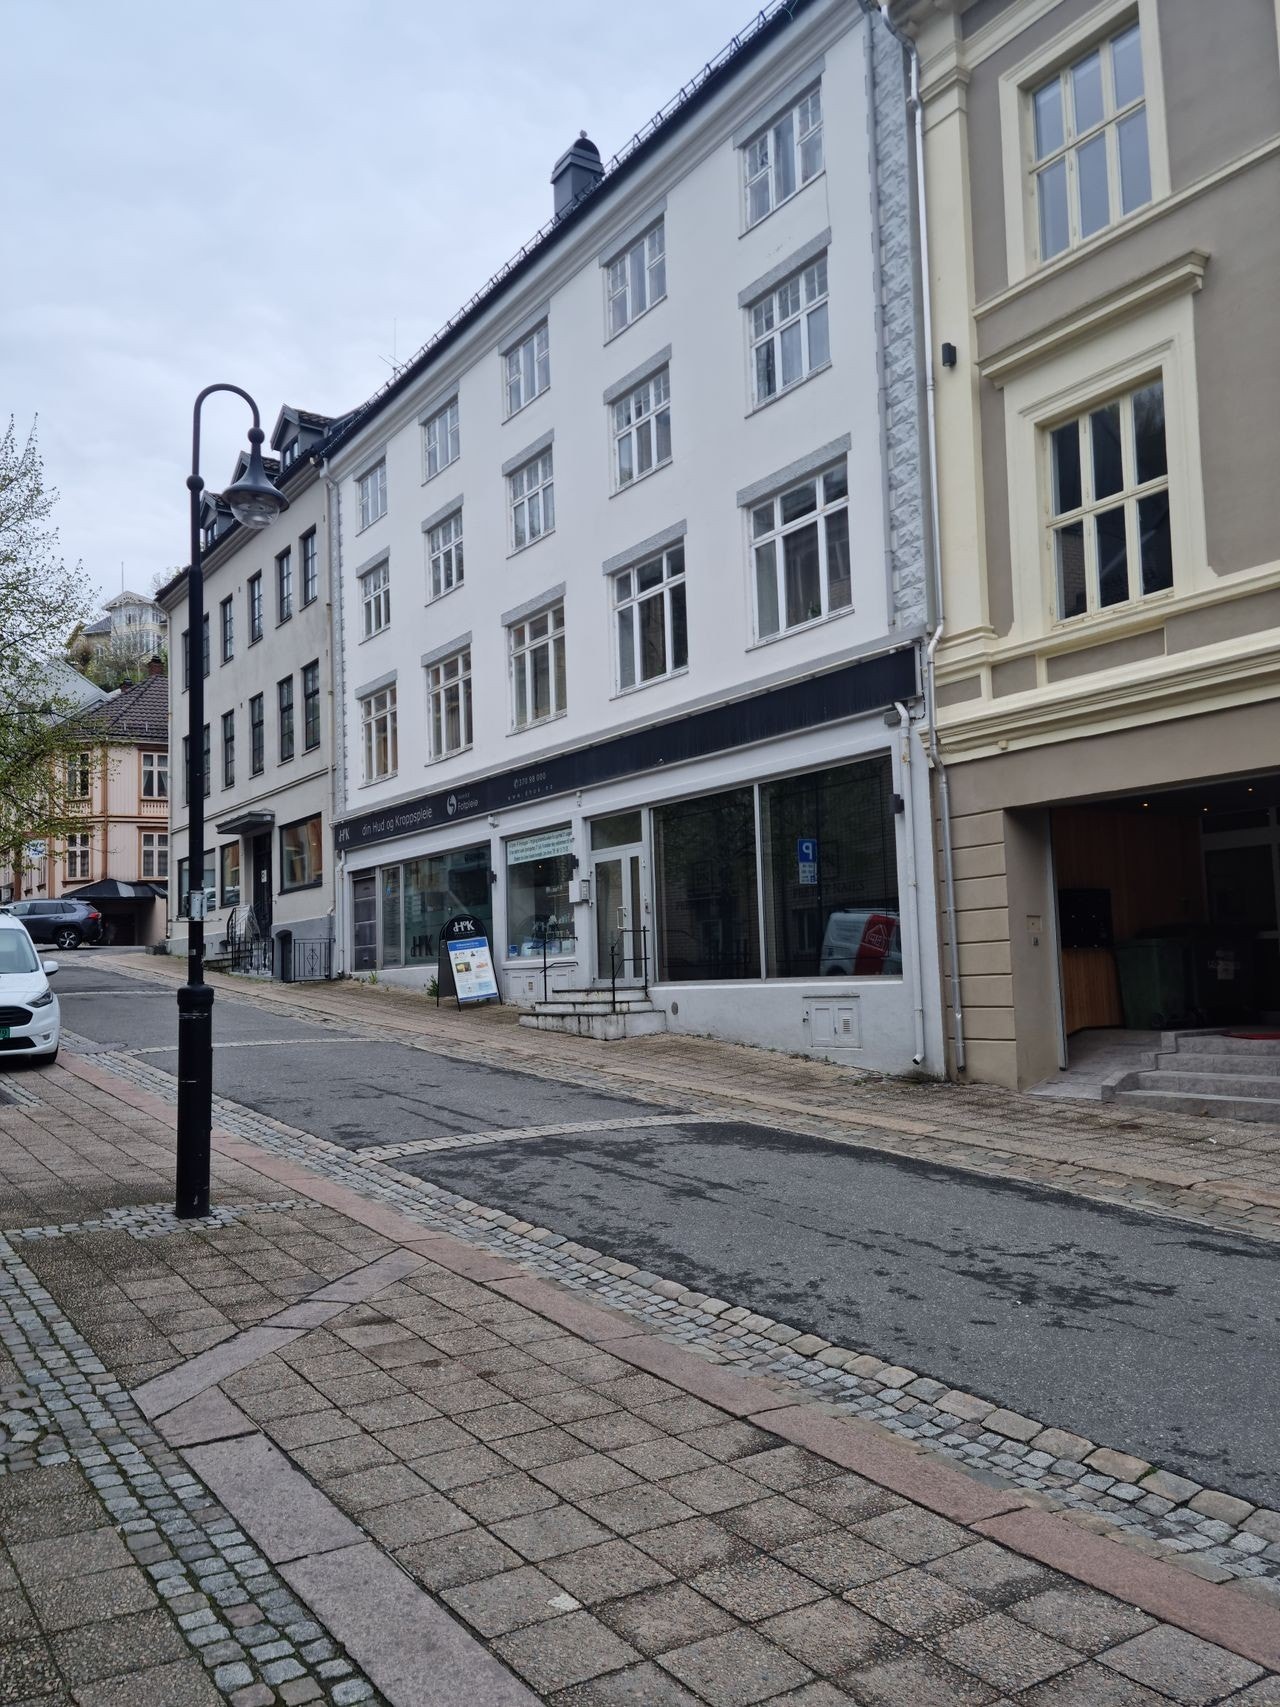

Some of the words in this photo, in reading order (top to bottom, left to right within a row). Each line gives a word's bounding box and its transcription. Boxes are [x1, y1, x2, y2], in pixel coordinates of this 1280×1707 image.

[362, 824, 372, 836] din
[372, 819, 385, 832] Hud
[386, 819, 394, 832] og
[395, 808, 432, 827] Kroppspleie
